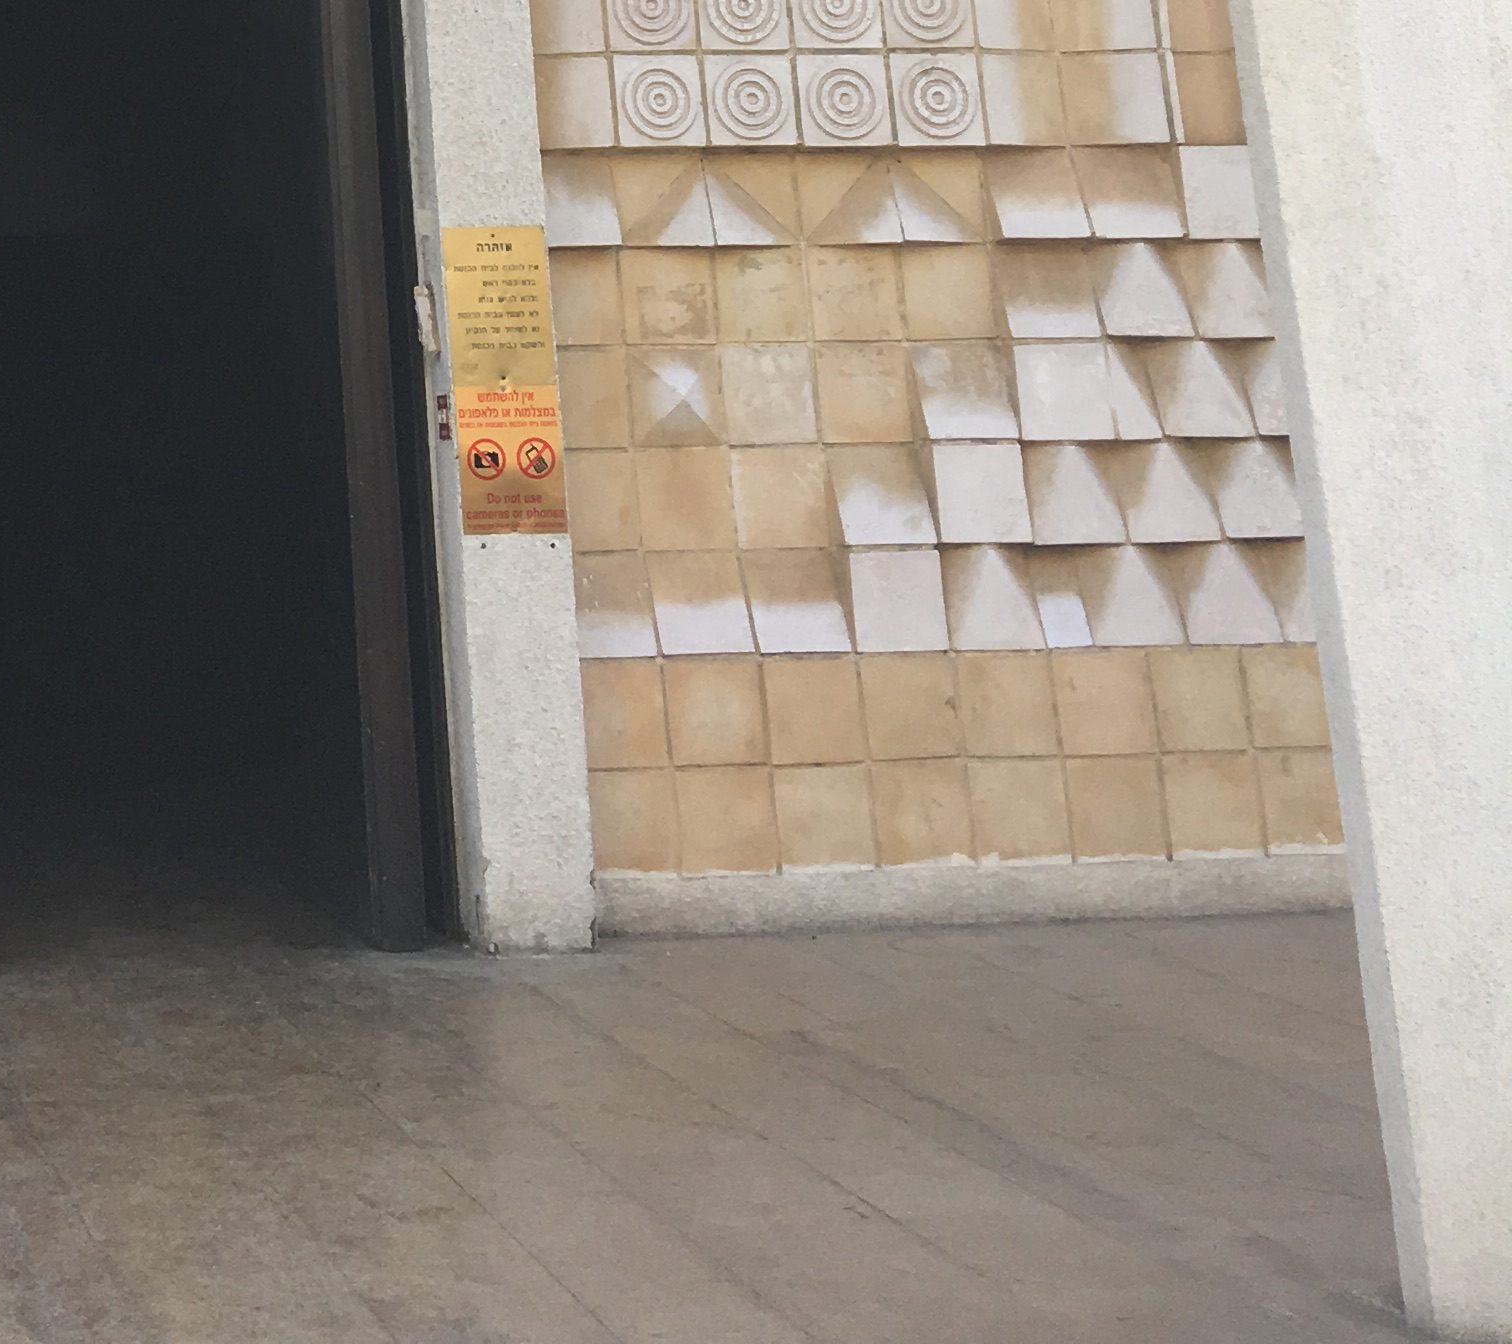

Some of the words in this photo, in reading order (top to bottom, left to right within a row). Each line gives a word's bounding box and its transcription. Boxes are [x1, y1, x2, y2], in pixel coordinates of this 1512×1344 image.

[476, 242, 513, 252] אזהרה
[477, 390, 519, 403] להשתמש
[521, 392, 535, 405] אין
[487, 493, 501, 504] Do
[504, 493, 521, 503] not
[524, 494, 542, 503] use
[466, 510, 510, 520] cameras
[512, 510, 522, 519] or
[526, 507, 565, 520] phones
